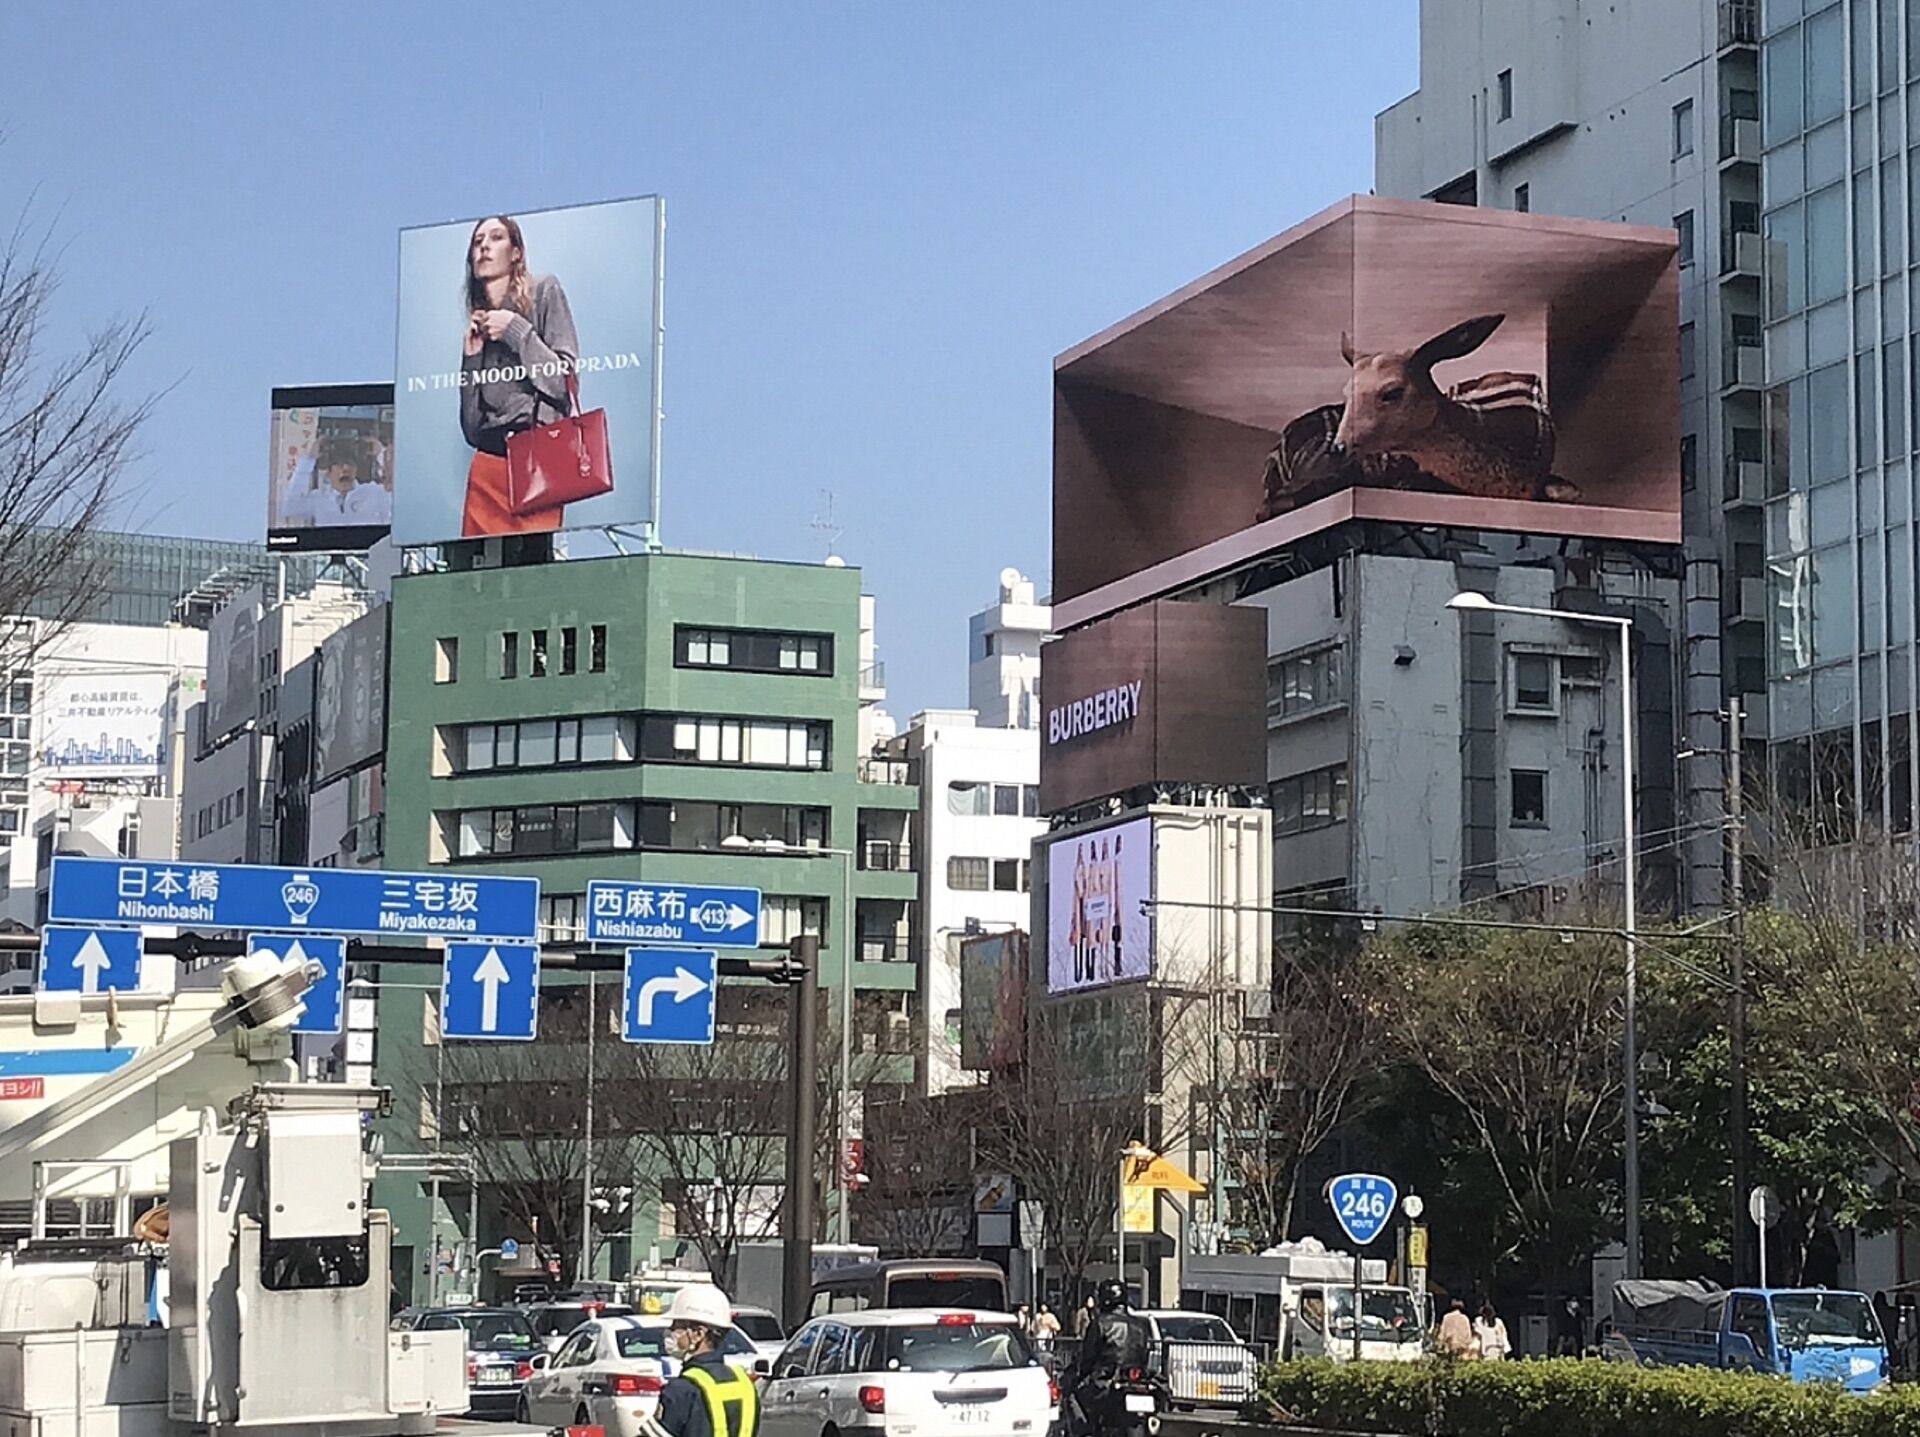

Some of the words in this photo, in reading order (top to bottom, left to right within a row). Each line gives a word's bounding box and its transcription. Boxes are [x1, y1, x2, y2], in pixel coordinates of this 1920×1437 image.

[408, 376, 426, 392] IN
[430, 372, 468, 389] THE
[472, 365, 527, 386] MOOD
[530, 359, 569, 379] FOR
[575, 353, 641, 373] PRADA
[1048, 679, 1142, 745] BURBERRY
[118, 866, 220, 902] 日本橋
[287, 886, 313, 903] 246
[380, 879, 479, 912] 三宅坂
[118, 900, 214, 920] Nihonbashi
[593, 887, 687, 920] 西麻布
[701, 908, 725, 925] 413
[379, 911, 477, 932] Miyakezaka
[596, 919, 682, 939] Nishiazabu
[1341, 1191, 1385, 1218] 246
